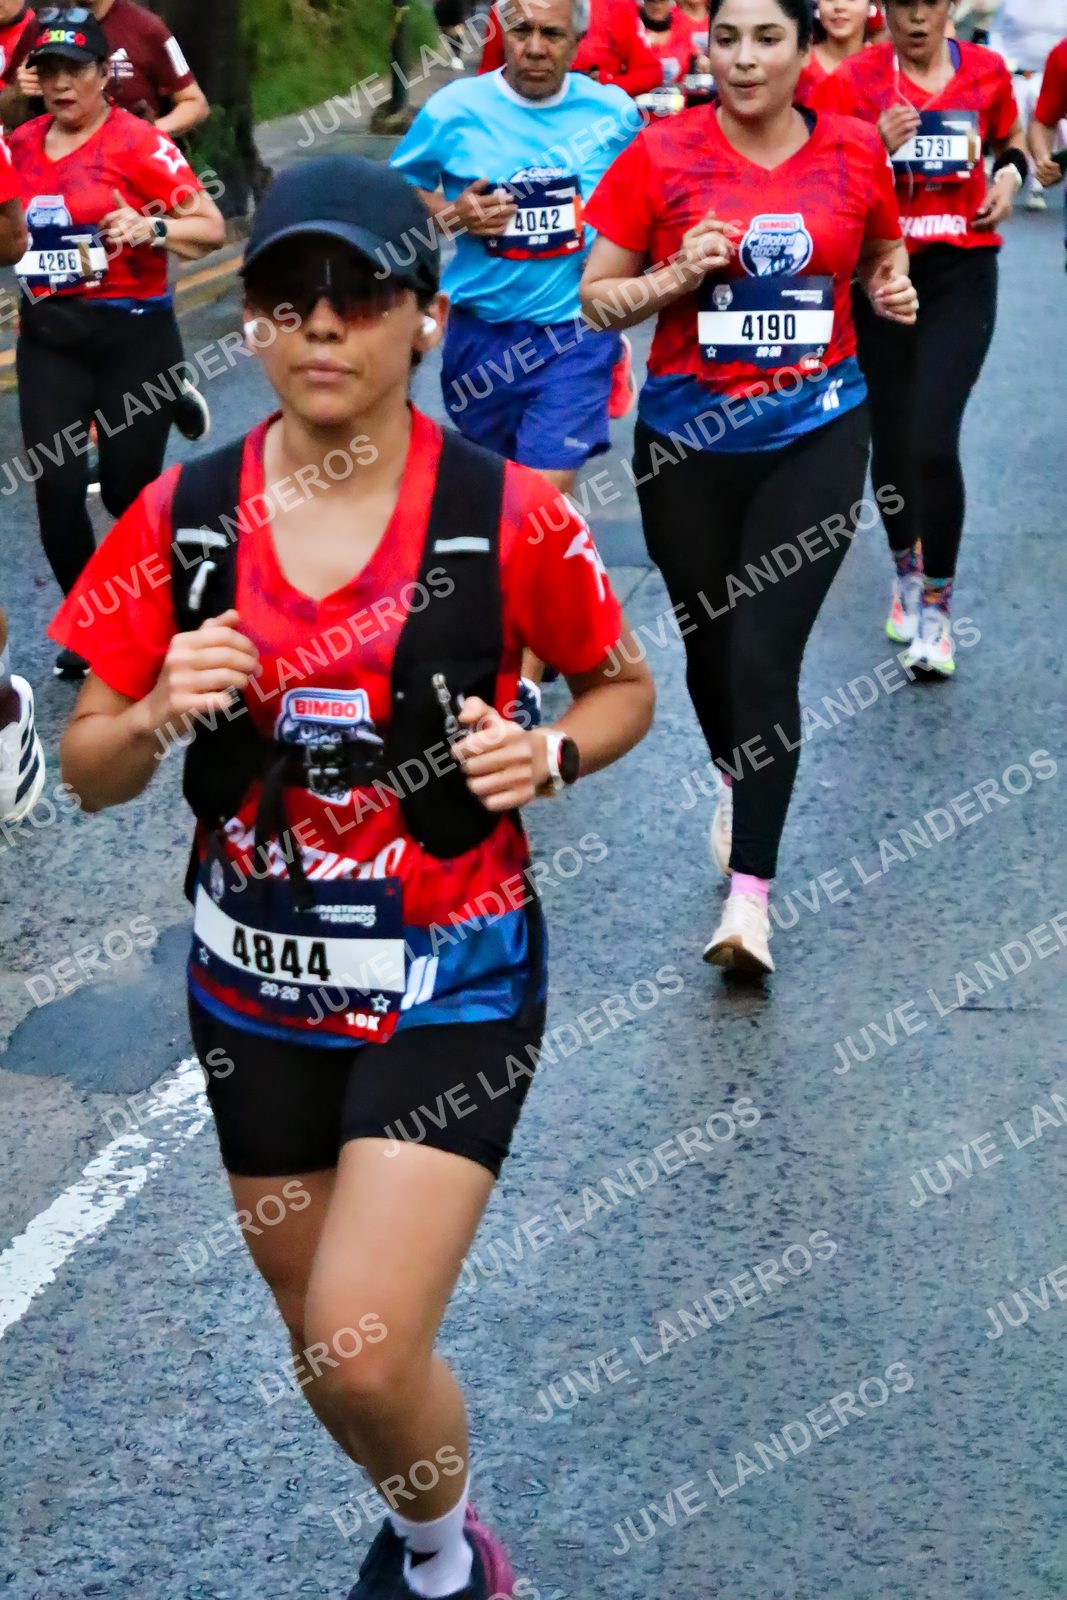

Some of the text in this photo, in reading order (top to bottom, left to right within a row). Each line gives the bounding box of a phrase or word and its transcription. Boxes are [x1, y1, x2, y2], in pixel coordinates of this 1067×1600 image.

[915, 138, 951, 158] 5731
[515, 208, 561, 232] 4042
[38, 251, 78, 272] 4286
[741, 313, 796, 341] 4190
[294, 699, 357, 718] BIMBO
[231, 924, 332, 983] 4844
[345, 1011, 381, 1033] 10K
